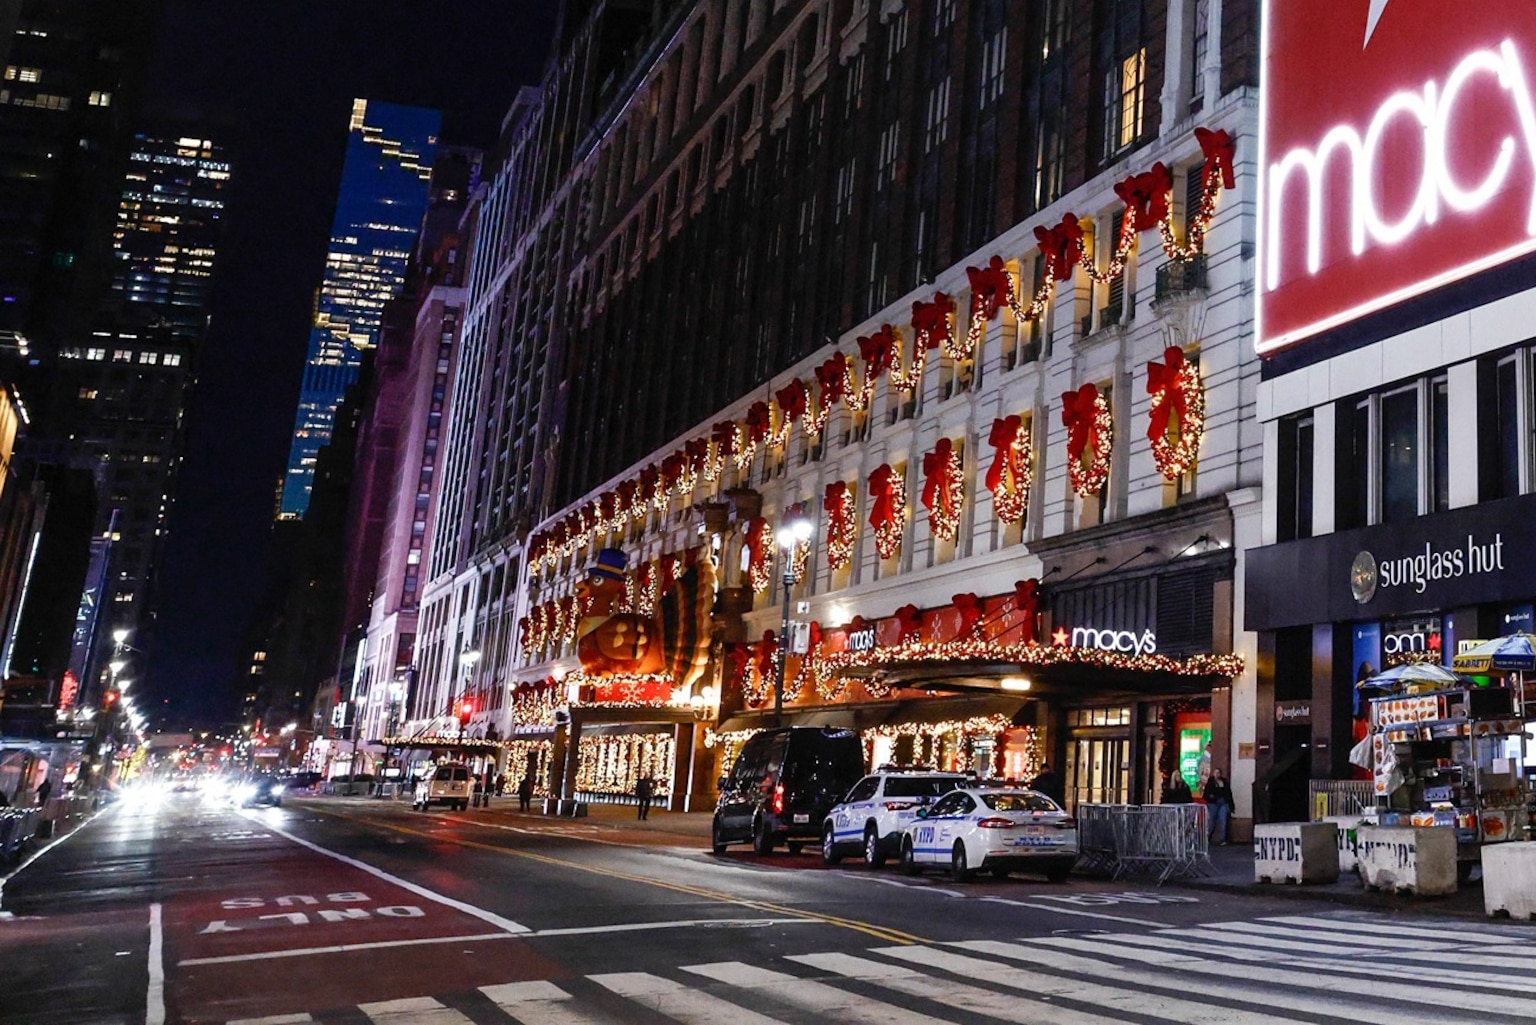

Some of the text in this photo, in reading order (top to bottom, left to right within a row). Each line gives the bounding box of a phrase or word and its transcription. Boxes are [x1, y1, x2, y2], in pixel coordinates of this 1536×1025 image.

[1380, 533, 1505, 593] sunglass hut
[1071, 627, 1156, 657] macy's
[1260, 837, 1295, 862] NYPD
[220, 892, 371, 909] BUS
[199, 905, 426, 935] ONLY
